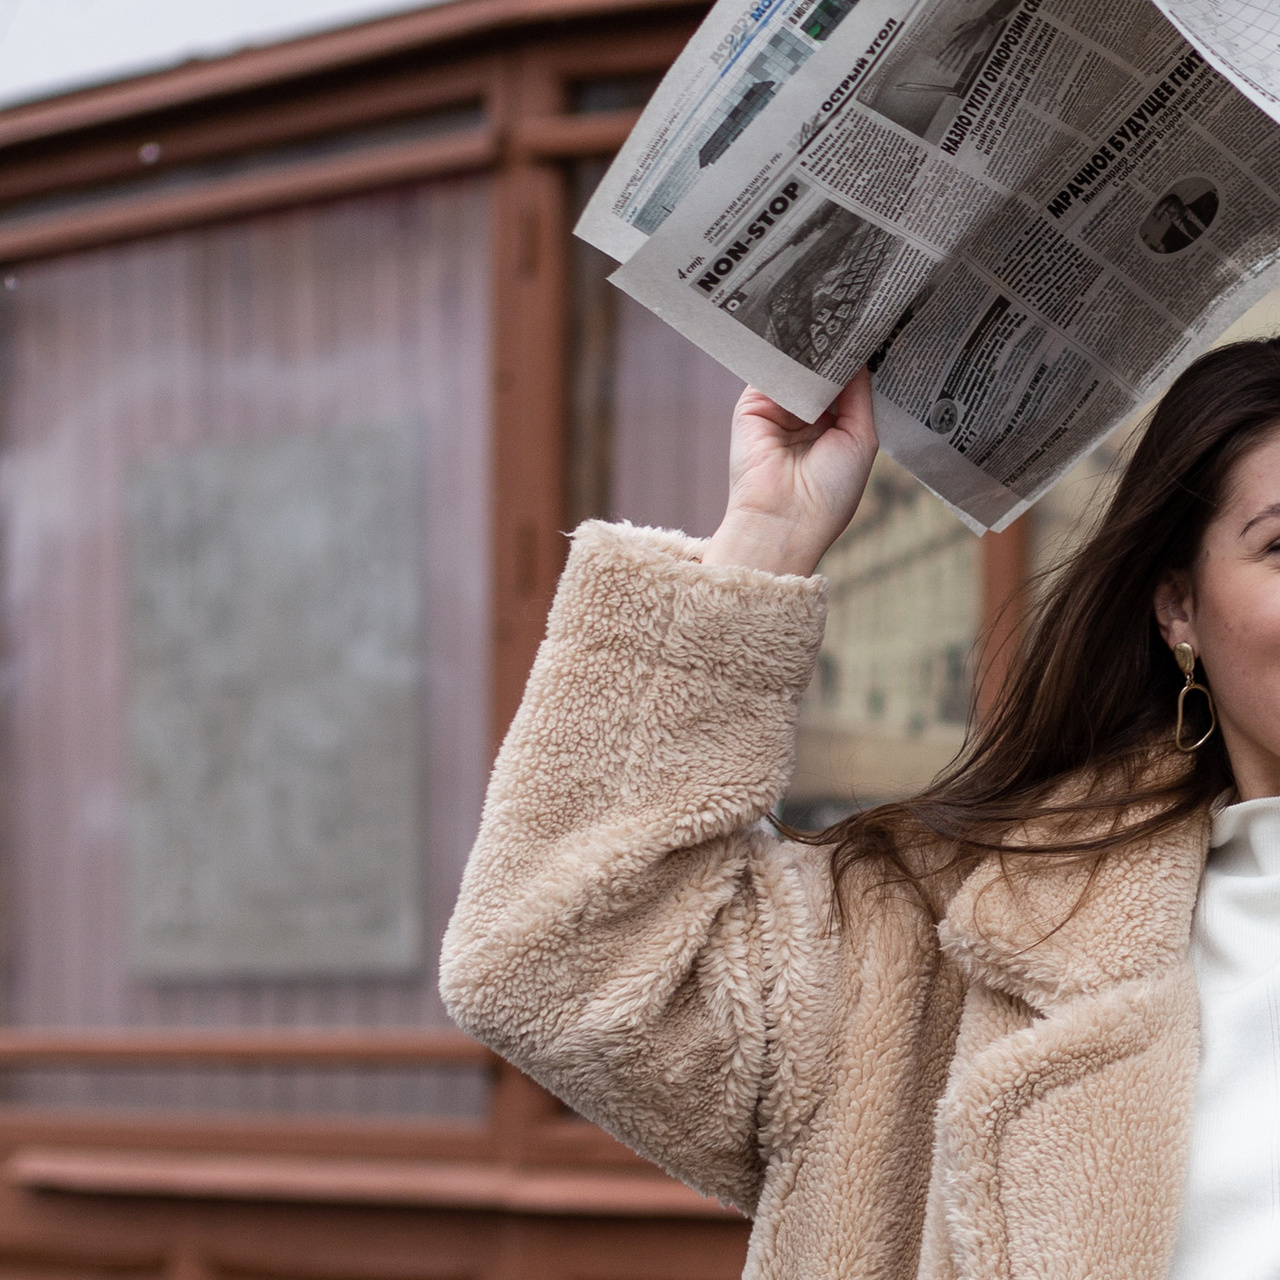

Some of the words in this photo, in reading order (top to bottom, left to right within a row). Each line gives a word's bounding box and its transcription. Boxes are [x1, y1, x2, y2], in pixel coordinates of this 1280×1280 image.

[819, 54, 869, 114] ОСТРЫЙ
[864, 16, 898, 57] УГОЛ
[938, 113, 975, 156] НАЗЛО
[960, 79, 993, 119] ГУГЛУ
[980, 9, 1035, 84] ОТМОРОЗИМ
[972, 117, 998, 151] сайтов
[990, 80, 1019, 118] нанесет
[1012, 56, 1033, 81] вред
[1025, 20, 1053, 57] прежде
[981, 128, 1003, 156] всего
[994, 74, 1034, 129] российской
[1025, 26, 1060, 75] экономике
[1003, 16, 1045, 76] иностранных
[1044, 144, 1118, 219] МРАЧНОЕ
[1106, 79, 1180, 155] БУДУЩЕЕ
[1080, 154, 1130, 205] Миллиардер
[1125, 123, 1158, 158] сравнил
[1153, 86, 1193, 127] грядущие
[1115, 136, 1160, 182] событиями
[1154, 109, 1185, 140] Второй
[1179, 76, 1215, 113] мировой
[673, 267, 688, 281] 4
[695, 178, 805, 295] NON-STOP
[1011, 391, 1036, 419] РАЗВОДЕ
